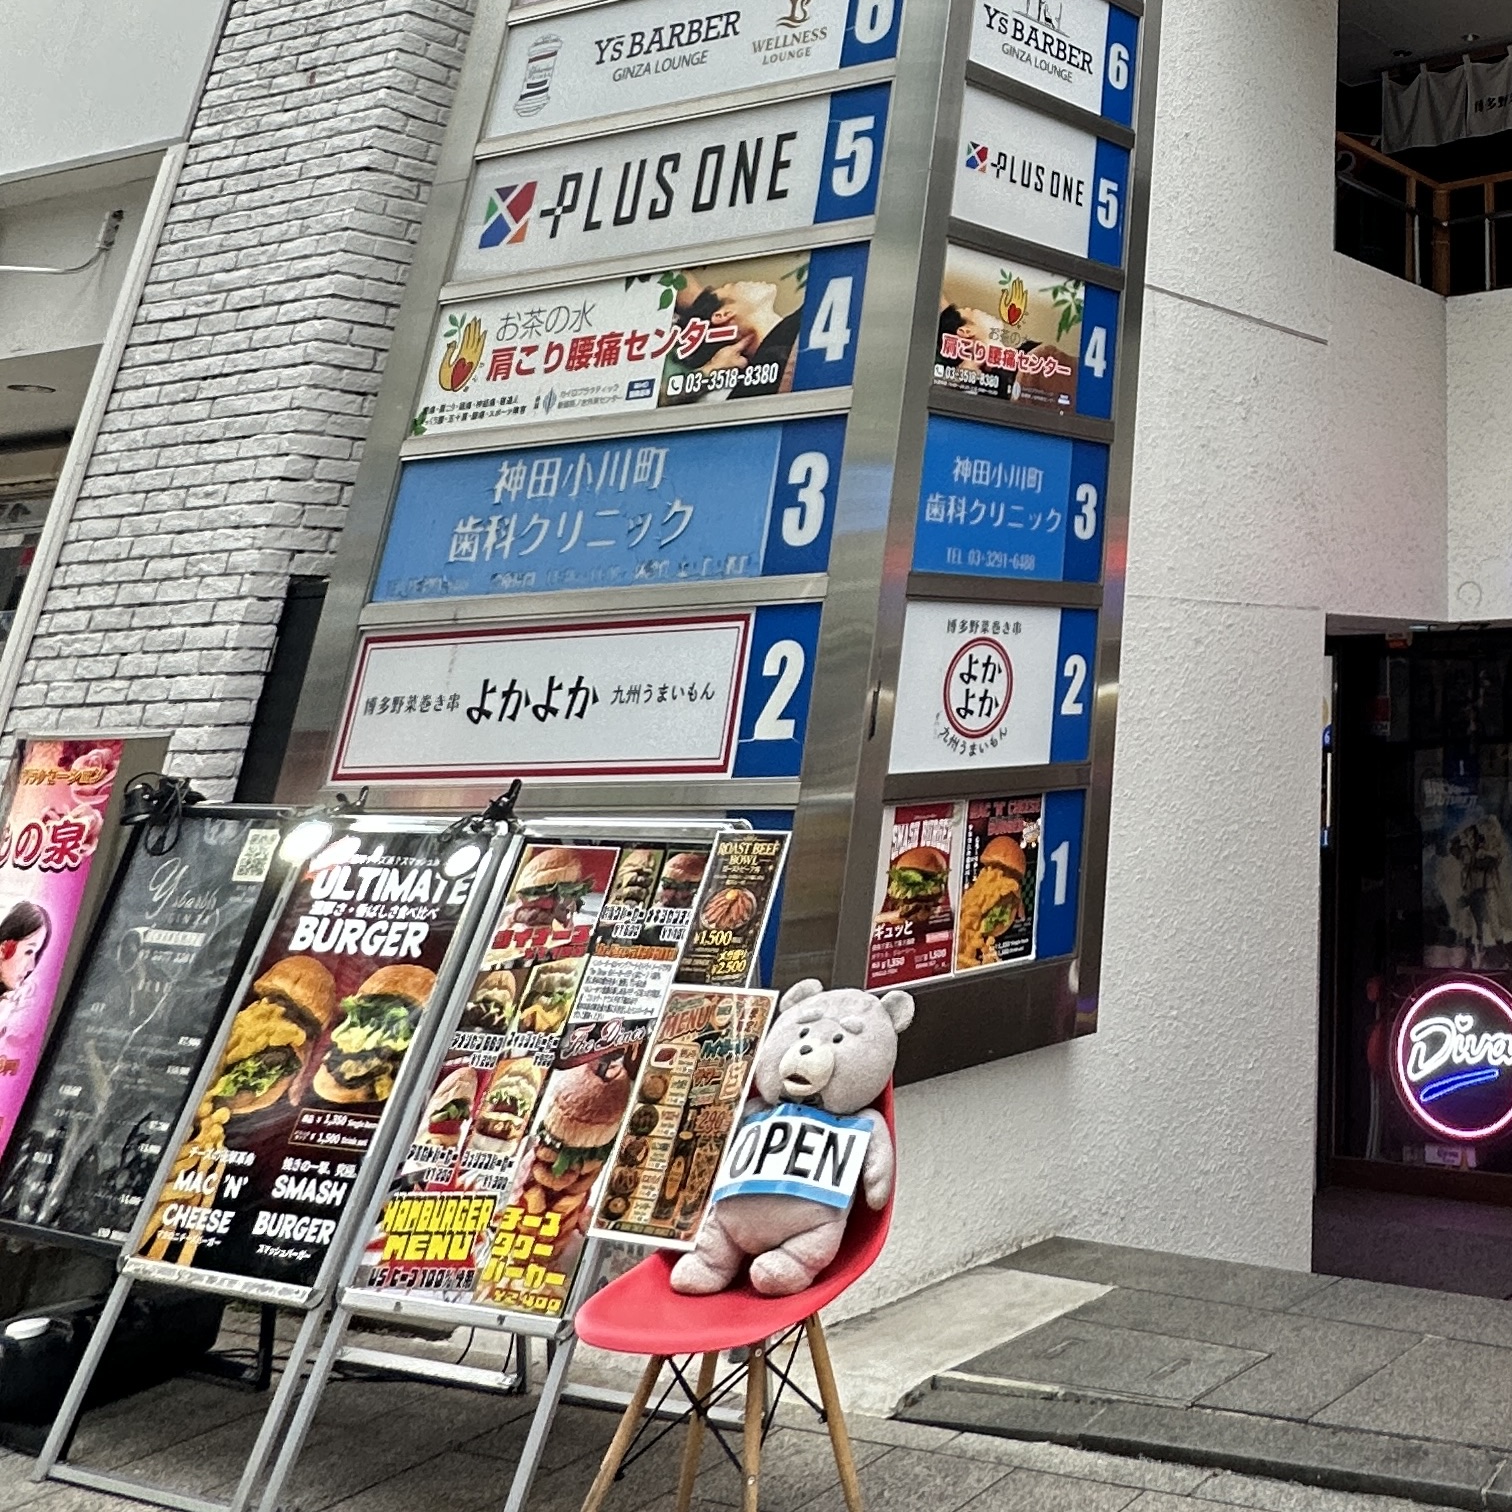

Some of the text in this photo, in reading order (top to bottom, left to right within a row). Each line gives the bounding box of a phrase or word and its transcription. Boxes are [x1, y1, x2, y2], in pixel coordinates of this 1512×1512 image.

[626, 10, 741, 58] BARBER
[752, 26, 828, 55] WELLNESS
[1011, 18, 1093, 75] BARBER
[613, 50, 709, 82] GINZA LOUNGE
[762, 47, 811, 65] LOUNGE
[1001, 42, 1073, 83] GINZA LOUNGE
[1107, 42, 1129, 90] 6
[692, 131, 798, 213] ONE
[831, 116, 875, 197] 5
[1050, 159, 1084, 206] ONE
[1097, 177, 1118, 229] 5
[496, 300, 596, 342] お茶の水
[809, 277, 855, 362] 4
[486, 317, 739, 382] 肩こり腰痛センター
[940, 333, 1071, 378] 肩こり腰痛センター
[1084, 326, 1107, 378] 4
[685, 363, 778, 392] 03-3518-8380
[493, 446, 669, 504] 神田小川町
[952, 455, 1044, 494] 神田小川町
[781, 451, 829, 547] 3
[925, 491, 1062, 534] 歯科クリニック
[1074, 483, 1098, 540] 3
[448, 498, 695, 564] 歯科クリニック
[946, 548, 963, 566] TEL
[754, 639, 805, 740] 2
[959, 653, 1002, 685] よか
[1061, 654, 1087, 715] 2
[364, 674, 715, 725] 博多野菜巻き串 よかよか 九州うまいもん
[956, 688, 999, 718] よか
[938, 725, 1008, 757] 九州うまいもん
[310, 865, 476, 905] ULTIMATE
[1051, 841, 1070, 905] 1
[288, 916, 430, 958] BURGER
[874, 919, 913, 940] ギュッと
[729, 1121, 857, 1188] OPEN
[172, 1170, 220, 1196] MAC
[271, 1174, 348, 1206] SMASH
[162, 1202, 236, 1234] CHEESE
[251, 1210, 337, 1245] BURGER
[382, 1195, 497, 1233] HAMBURGER
[381, 1232, 476, 1261] MENU
